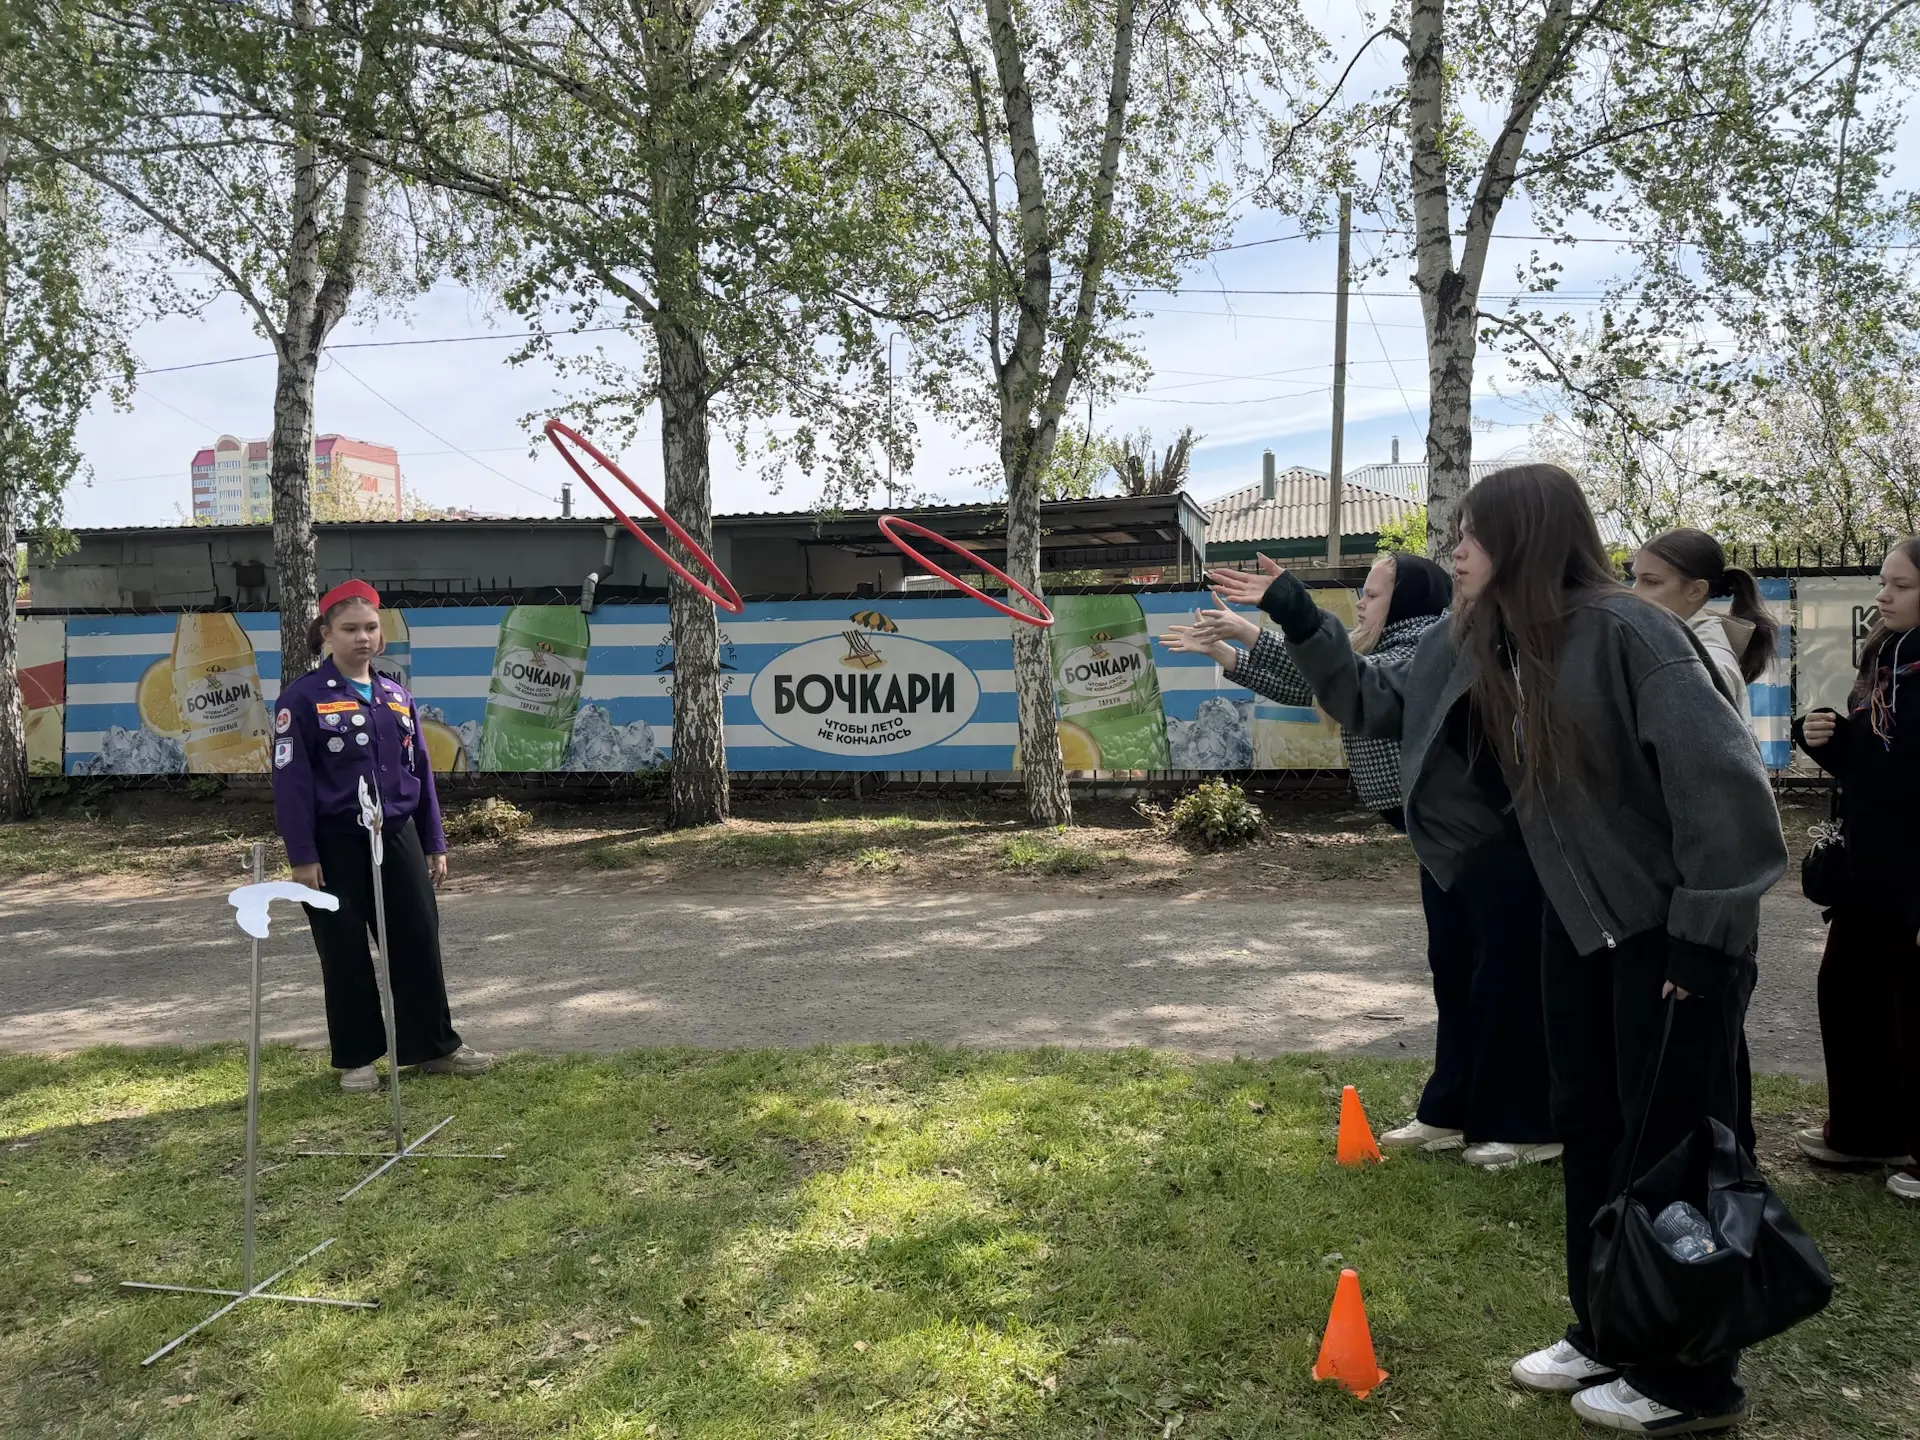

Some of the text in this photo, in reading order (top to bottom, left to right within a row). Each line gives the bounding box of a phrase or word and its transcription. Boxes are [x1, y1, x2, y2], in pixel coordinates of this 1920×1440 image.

[503, 661, 571, 690] БОЧКАРИ
[1065, 653, 1141, 685] БОЧКАРИ
[187, 683, 250, 713] БОЧКАРИ
[774, 673, 955, 714] БОЧКАРИ
[817, 728, 912, 745] НЕ КОНЧАЛОСЬ
[825, 717, 904, 734] ЧТОБЫ ЛЕТО
